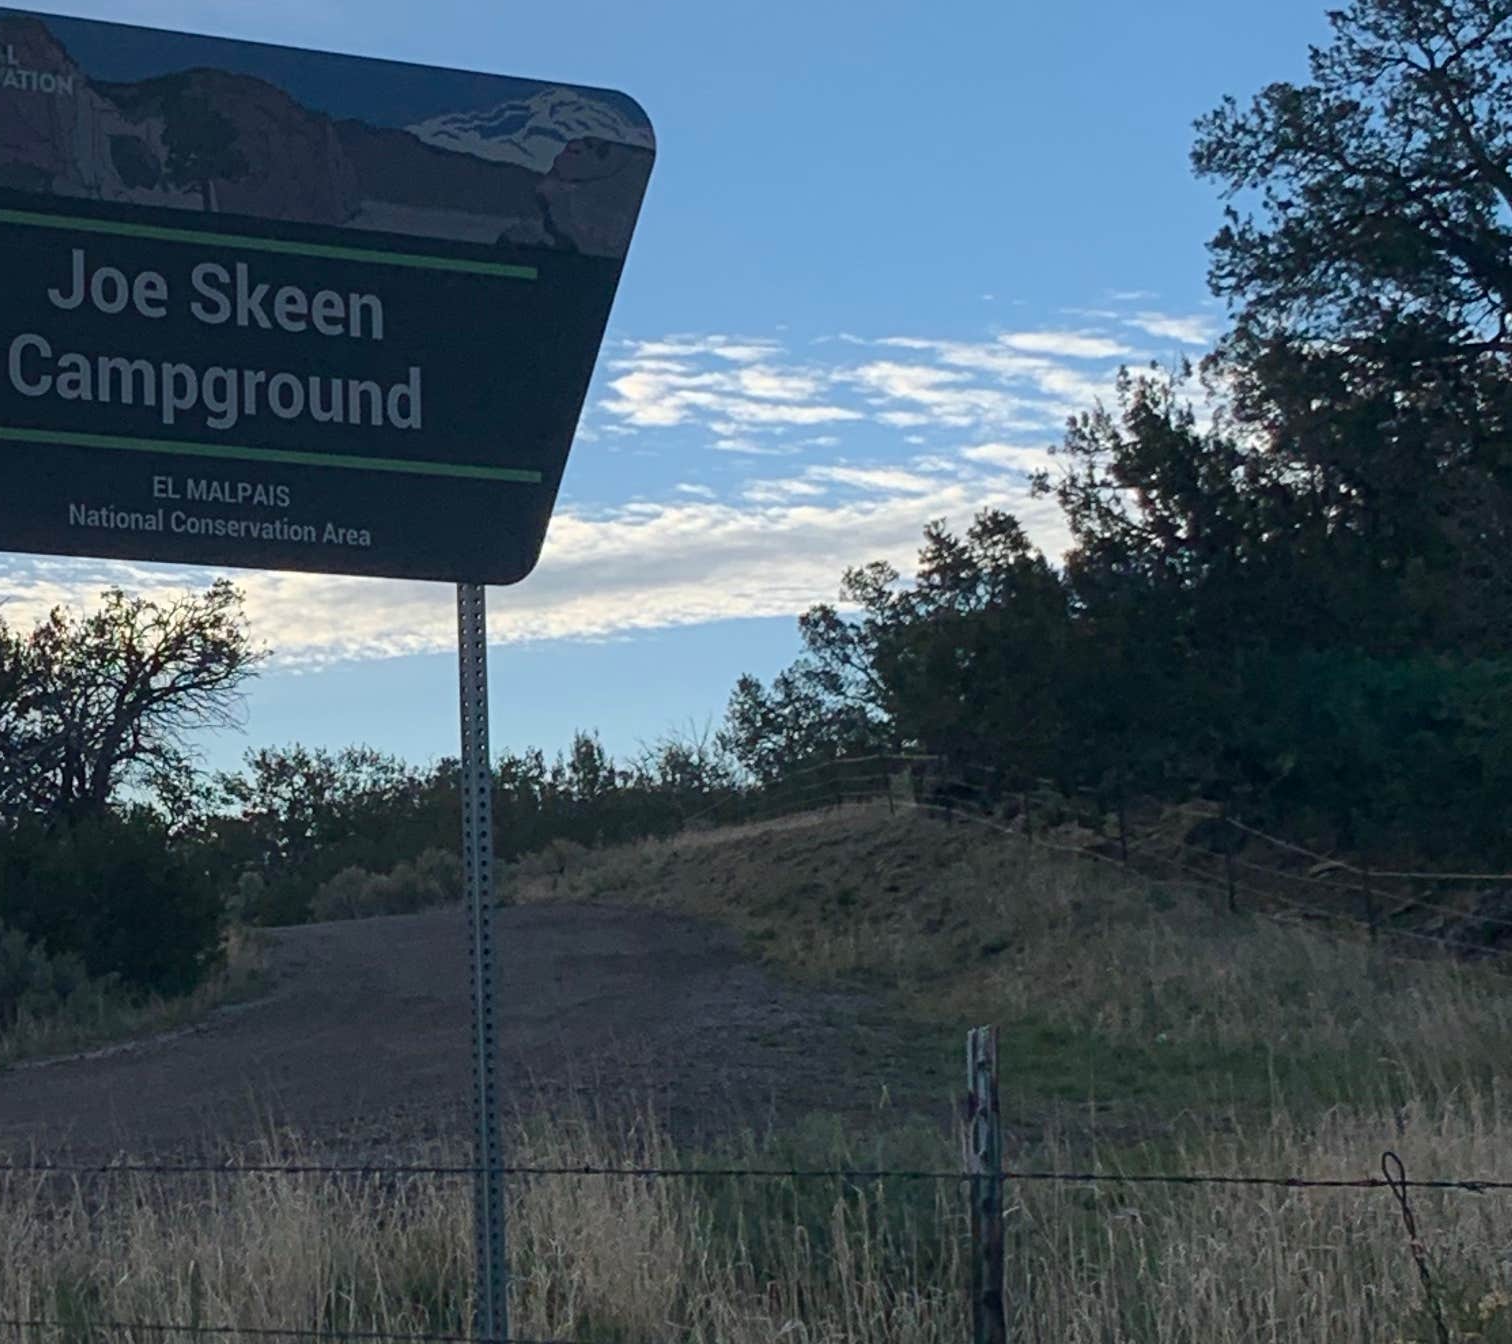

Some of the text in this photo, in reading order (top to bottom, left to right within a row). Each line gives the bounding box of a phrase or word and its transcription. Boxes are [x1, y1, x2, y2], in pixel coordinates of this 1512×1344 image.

[48, 249, 384, 340] Joe Skeen
[8, 334, 422, 430] Campground
[152, 475, 290, 508] EL MALPAIS
[69, 504, 372, 547] National Conservation Area
